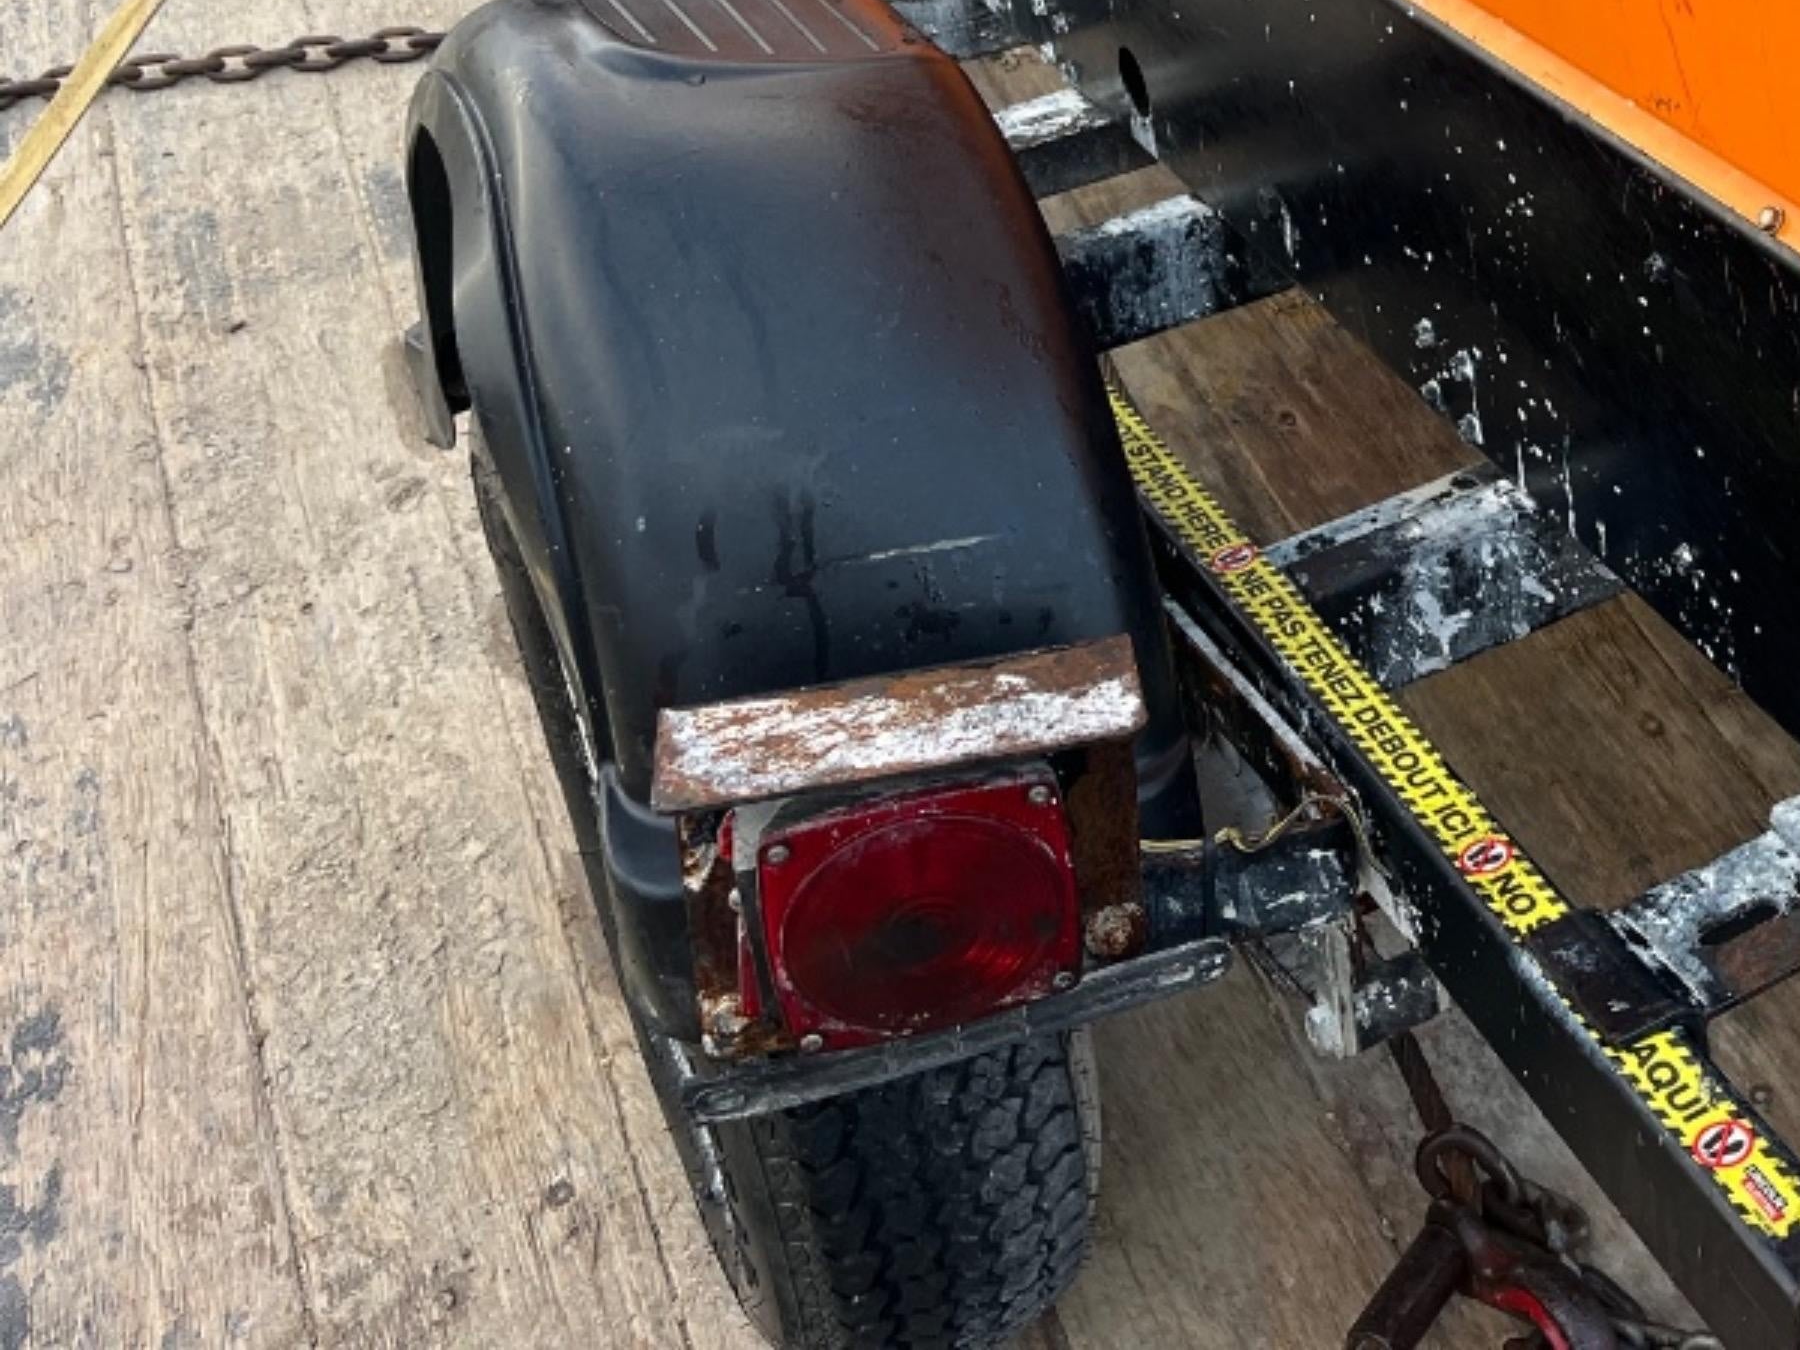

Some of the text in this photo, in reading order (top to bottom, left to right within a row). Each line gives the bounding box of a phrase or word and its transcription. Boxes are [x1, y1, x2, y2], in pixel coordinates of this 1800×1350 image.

[1128, 442, 1188, 499] STAND
[1177, 494, 1231, 548] HERE
[1236, 570, 1478, 842] NE PAS TENEZ DEBOUT ICI
[1487, 871, 1538, 917] NO
